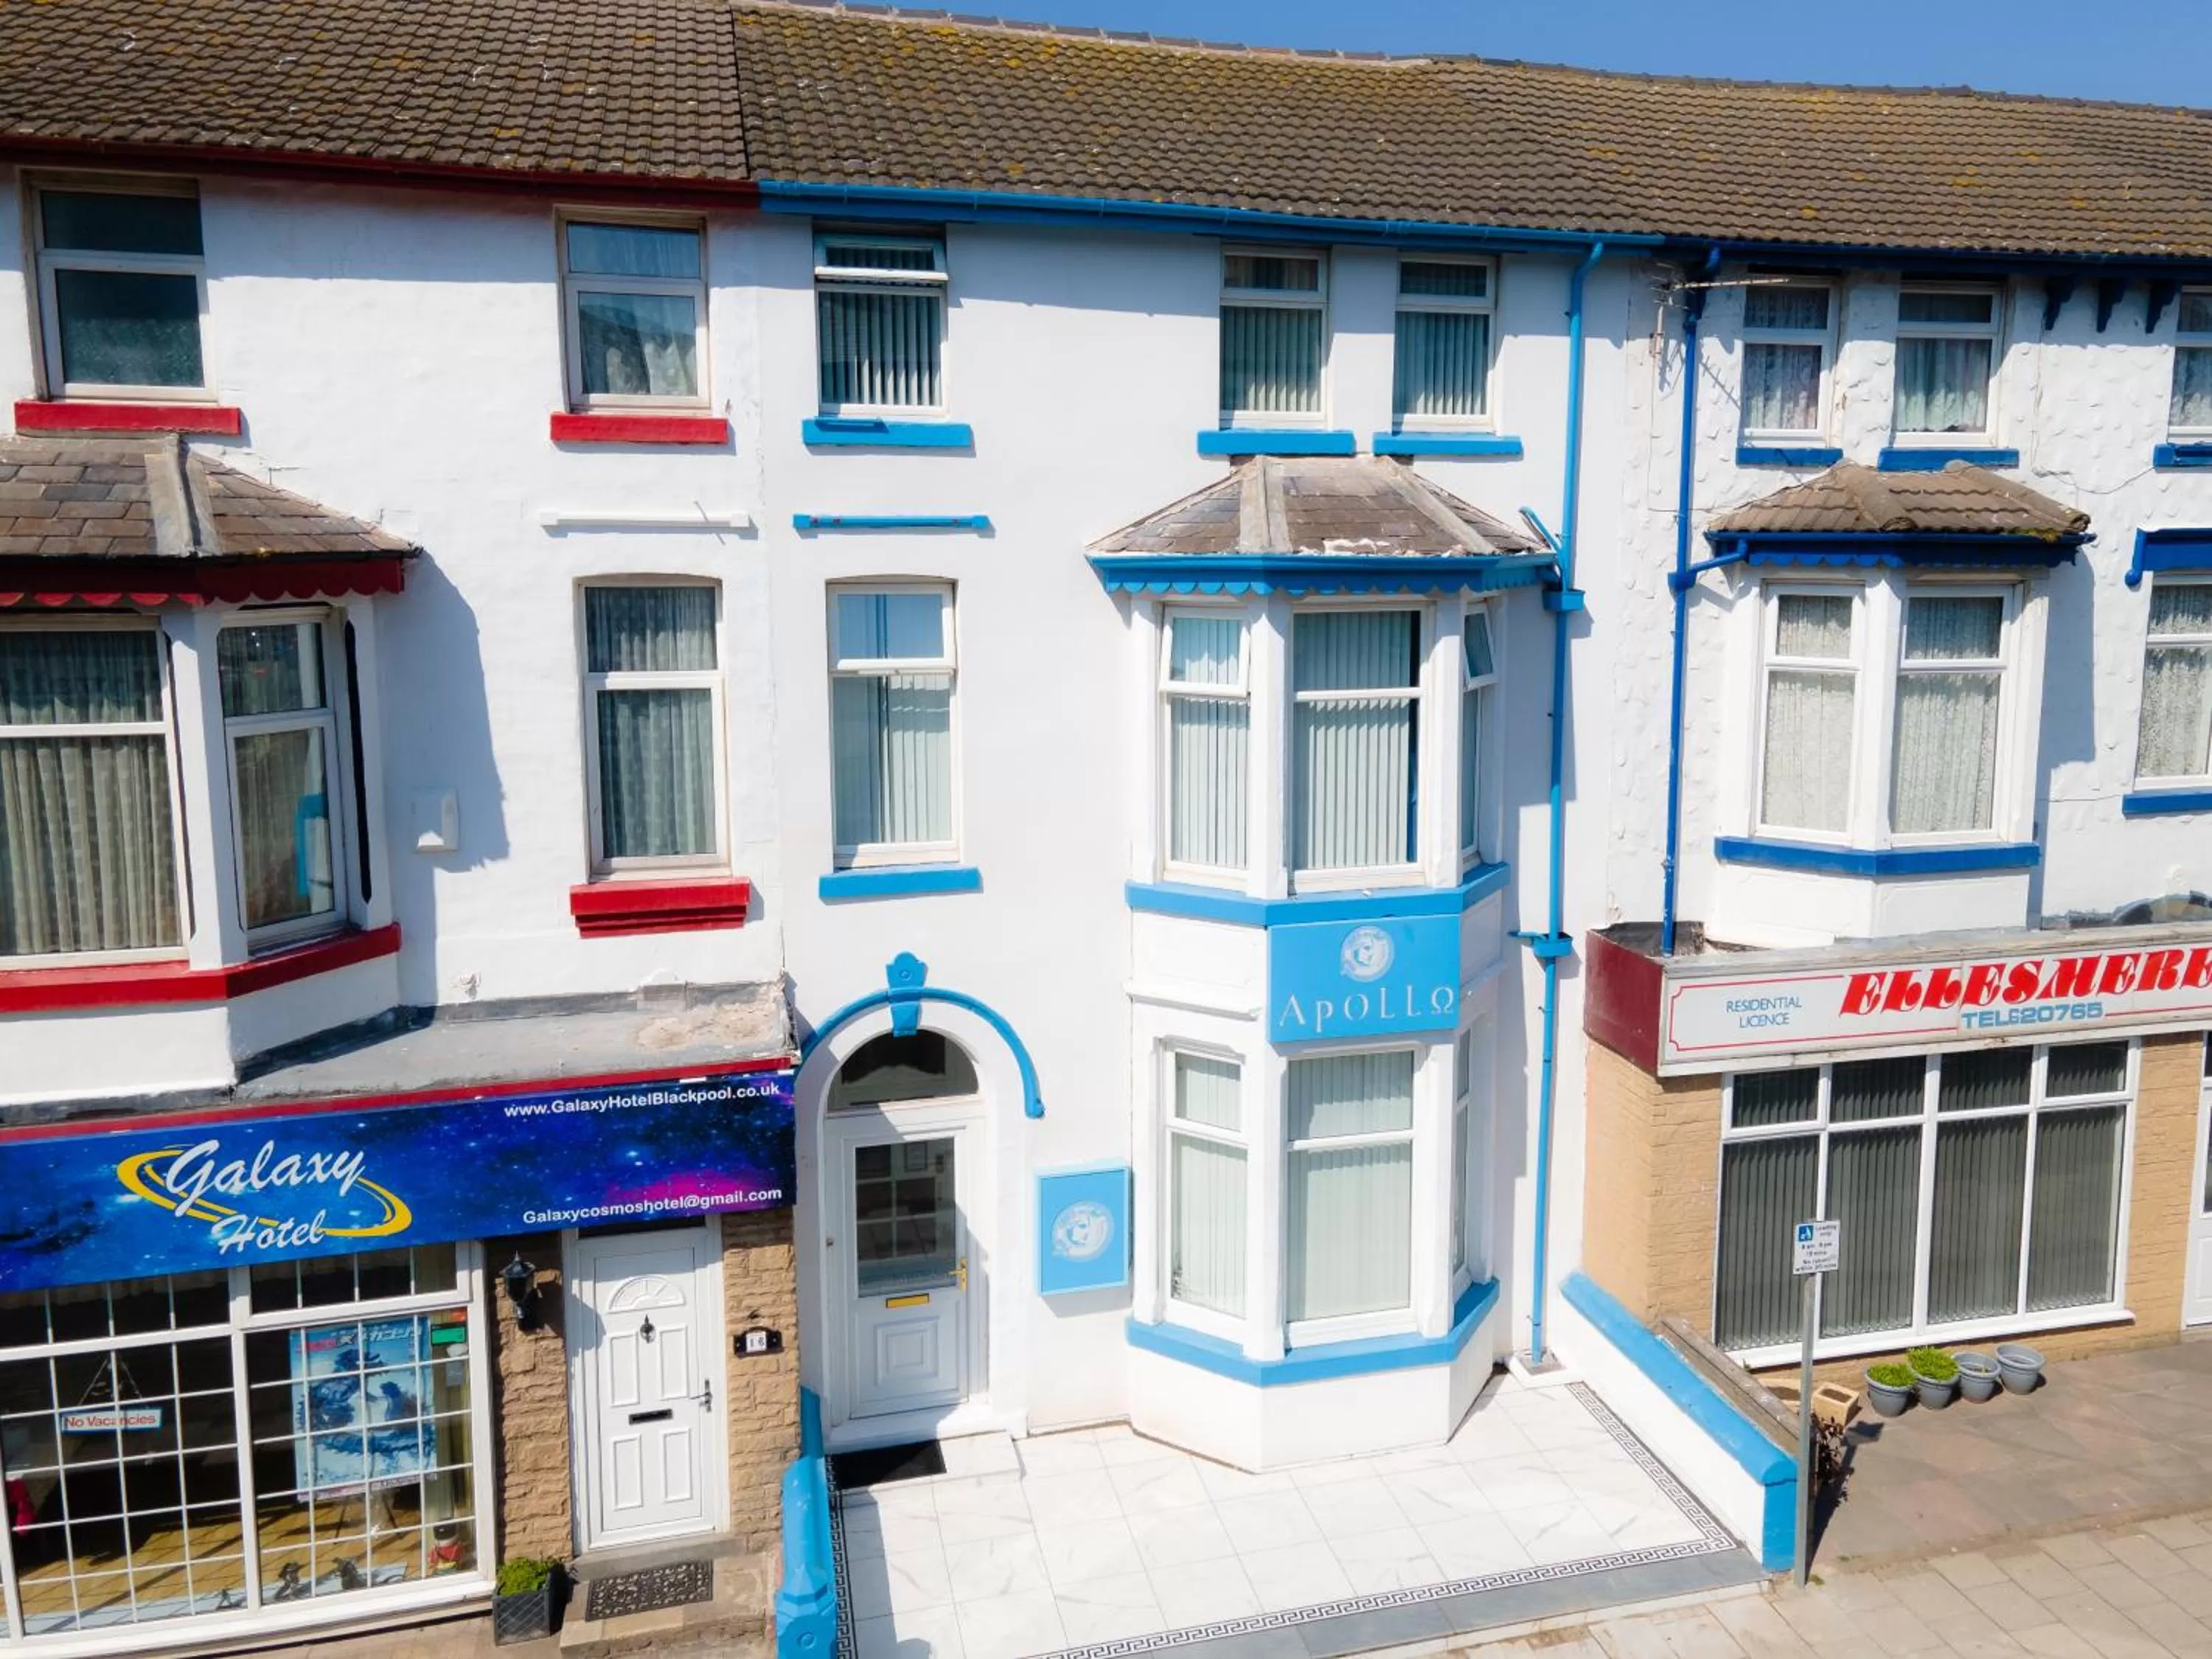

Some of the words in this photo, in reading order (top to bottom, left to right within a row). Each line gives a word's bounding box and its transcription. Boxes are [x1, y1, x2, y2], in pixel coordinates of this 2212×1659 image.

[1839, 948, 2212, 1018] ELLESMERE
[1726, 996, 1803, 1013] RESIDENTIAL
[1739, 1012, 1790, 1029] LICENCE
[504, 1081, 780, 1118] www.GalaxyHotelBlackpool.co.uk
[165, 1139, 366, 1217] Galaxy
[523, 1188, 782, 1224] Galaxycosmoshotel@gmail.com
[211, 1208, 327, 1255] Hotel
[66, 1416, 84, 1427] No
